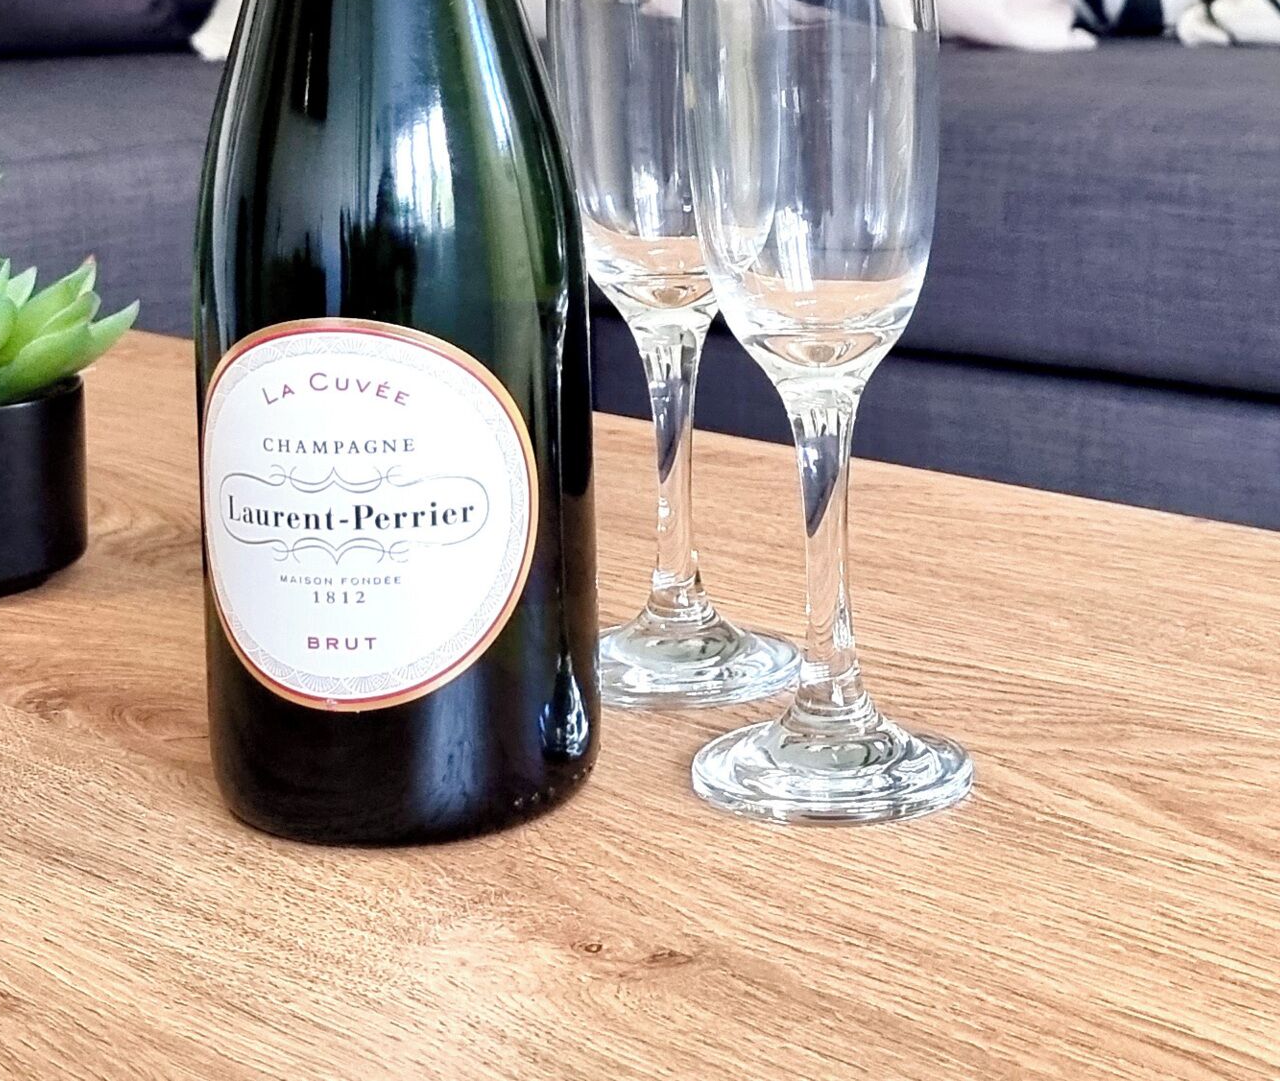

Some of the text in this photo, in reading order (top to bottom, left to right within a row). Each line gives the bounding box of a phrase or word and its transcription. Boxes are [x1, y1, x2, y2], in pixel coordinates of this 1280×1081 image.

[309, 372, 411, 406] CUVÉE
[262, 437, 416, 455] CHAMPAGNE
[227, 494, 476, 531] Laurent-Perrier
[279, 574, 402, 586] MAISON FONDÉE
[312, 590, 367, 605] 1812
[306, 636, 378, 651] BRUT
